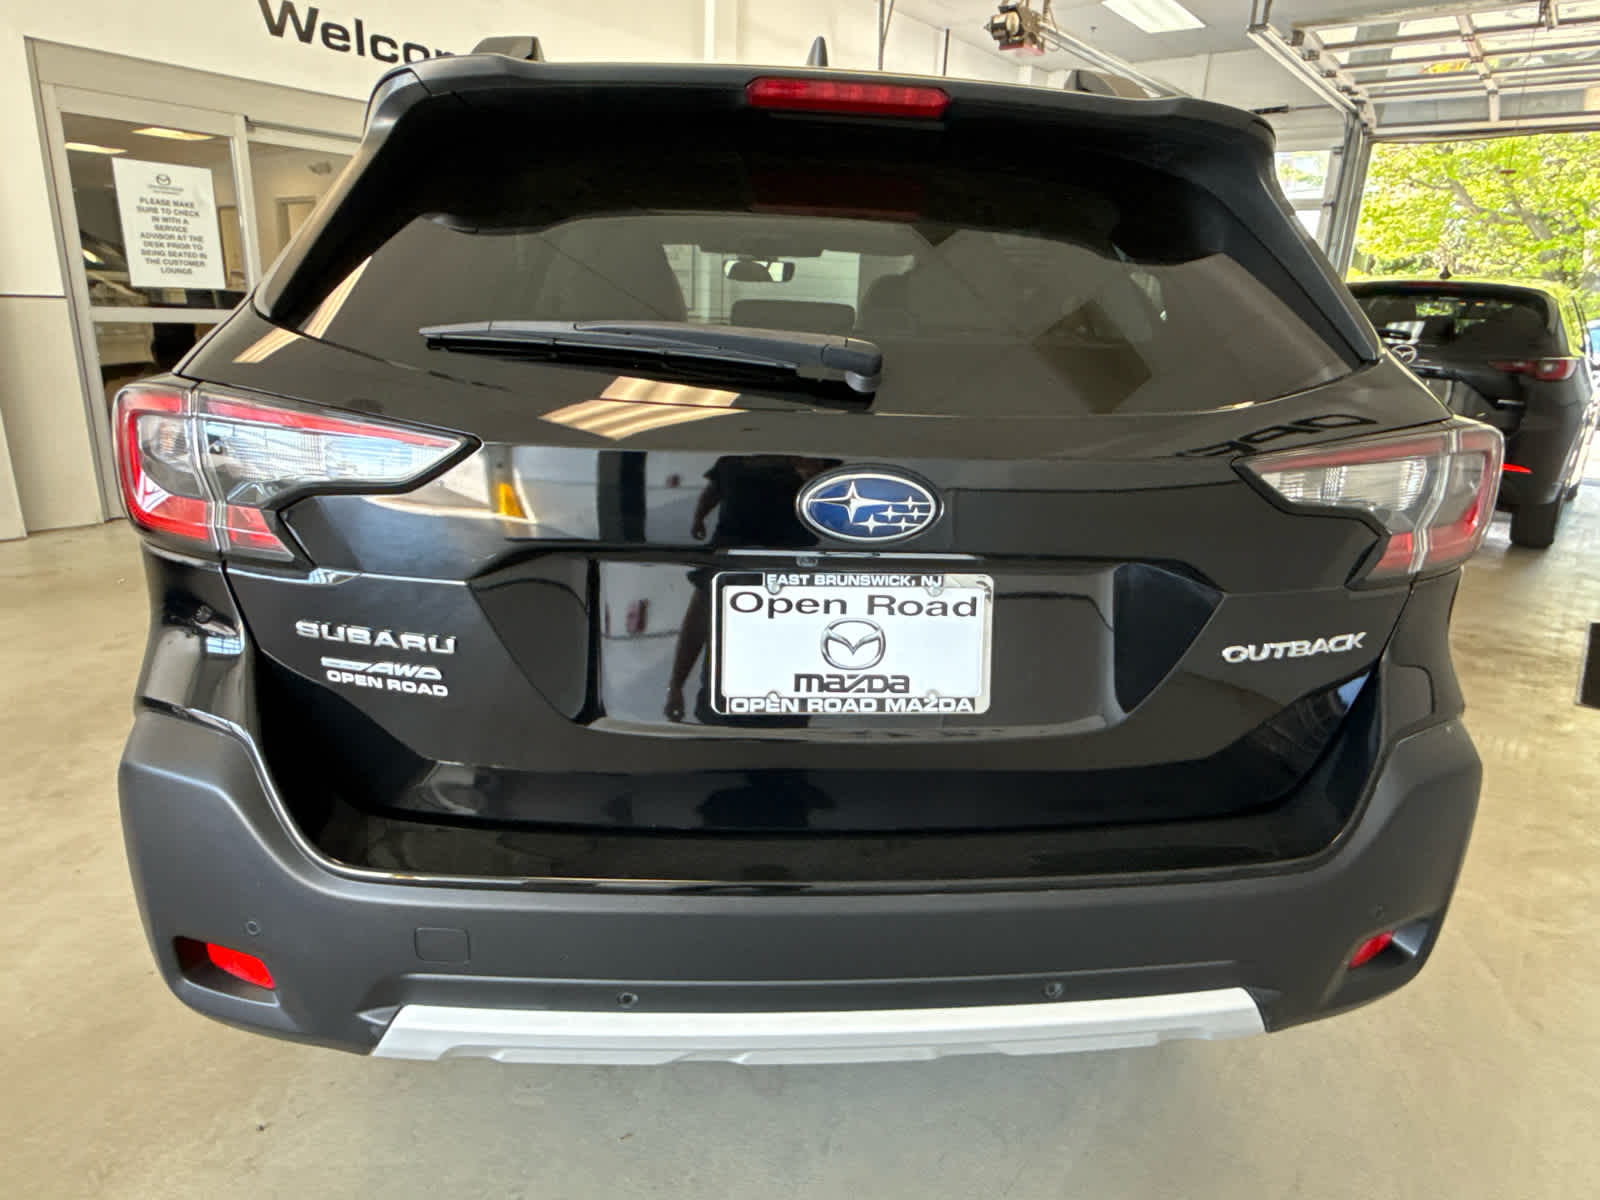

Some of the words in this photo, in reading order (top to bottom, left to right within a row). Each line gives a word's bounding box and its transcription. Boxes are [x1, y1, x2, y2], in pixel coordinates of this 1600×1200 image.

[258, 0, 455, 64] Welco
[139, 197, 170, 206] PLEASE
[172, 200, 195, 209] MAKE
[136, 206, 159, 214] SURE
[173, 209, 200, 217] CHECK
[153, 224, 188, 233] SERVICE
[141, 232, 176, 241] ADVISOR
[167, 242, 191, 250] PRIOR
[192, 243, 203, 251] TO
[141, 249, 166, 257] BEING
[168, 250, 198, 259] SEATED
[199, 252, 208, 260] IN
[145, 257, 161, 265] THE
[162, 259, 206, 267] CUSTOMER
[160, 266, 193, 274] LOUNGE
[766, 574, 810, 587] EAST
[816, 574, 916, 587] BRUNSWICK,
[921, 575, 943, 587] NJ
[729, 591, 848, 619] Open
[867, 594, 978, 617] Road
[295, 620, 457, 655] SUBARU
[1221, 631, 1368, 664] OUTBACK
[365, 661, 442, 680] AWD
[326, 670, 383, 689] OPEN
[386, 679, 449, 697] ROAD
[730, 697, 800, 713] OPEN
[806, 698, 878, 713] ROAD
[884, 697, 975, 713] MAZDA
